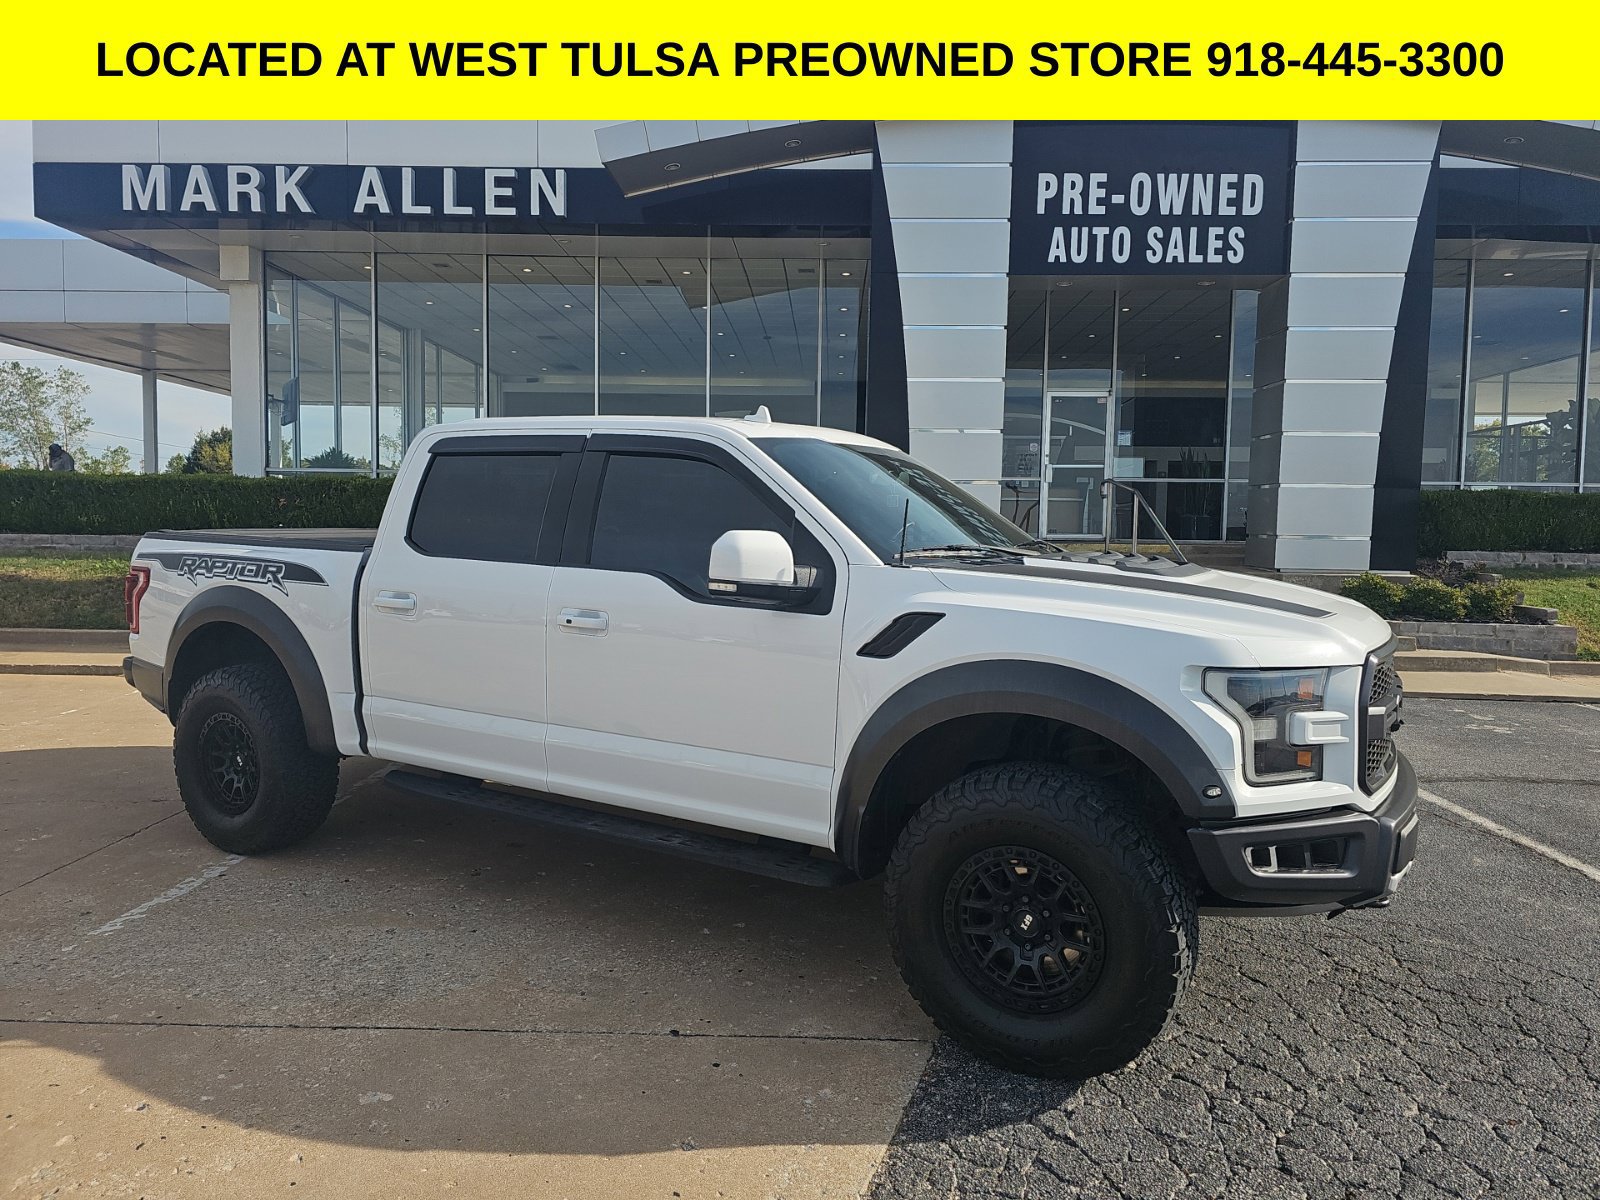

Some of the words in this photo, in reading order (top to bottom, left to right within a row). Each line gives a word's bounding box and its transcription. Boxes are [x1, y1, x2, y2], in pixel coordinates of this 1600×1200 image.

[121, 164, 315, 214] MARK
[353, 166, 568, 217] ALLEN
[1036, 172, 1264, 216] PRE-OWNED
[1048, 226, 1131, 263] AUTO
[1146, 226, 1245, 263] SALES
[177, 557, 289, 597] RAPTOR
